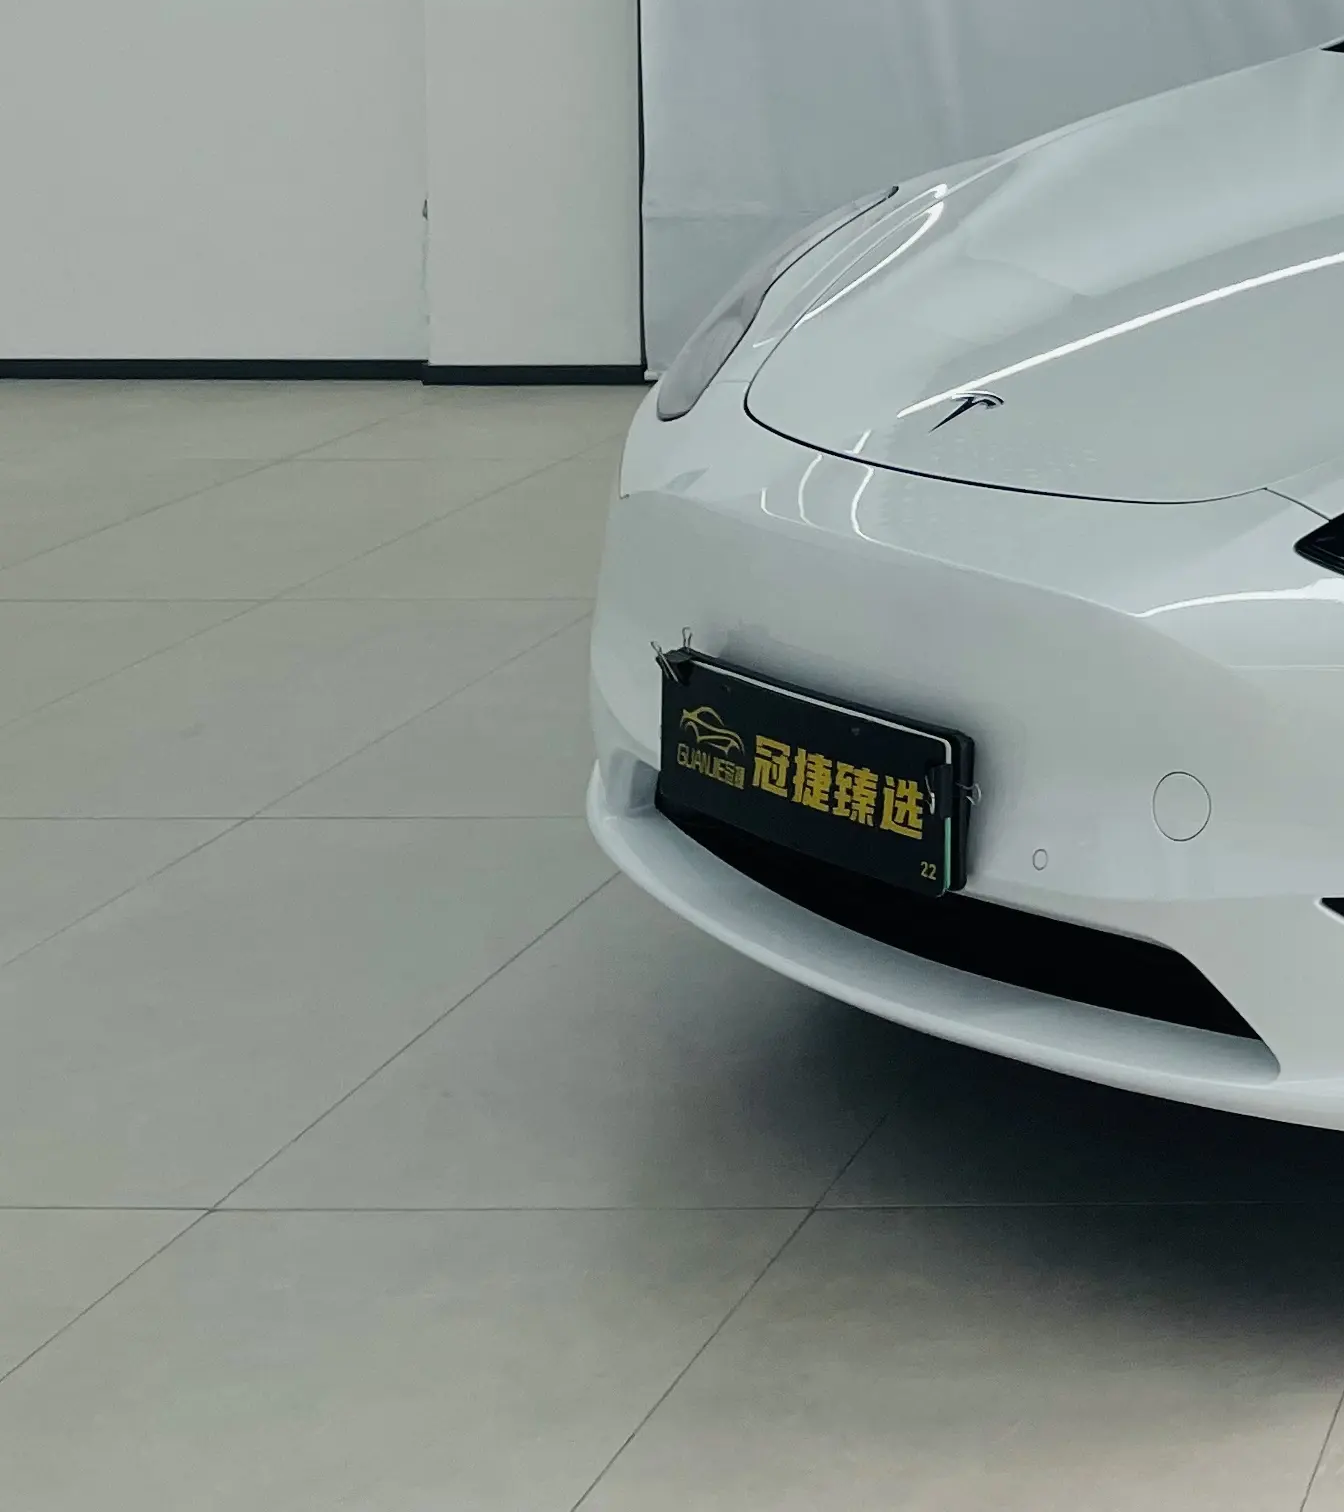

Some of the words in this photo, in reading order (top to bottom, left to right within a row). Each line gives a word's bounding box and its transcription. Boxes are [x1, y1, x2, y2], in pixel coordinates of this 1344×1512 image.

[752, 734, 924, 840] 冠捷臻选
[920, 860, 937, 881] 22
